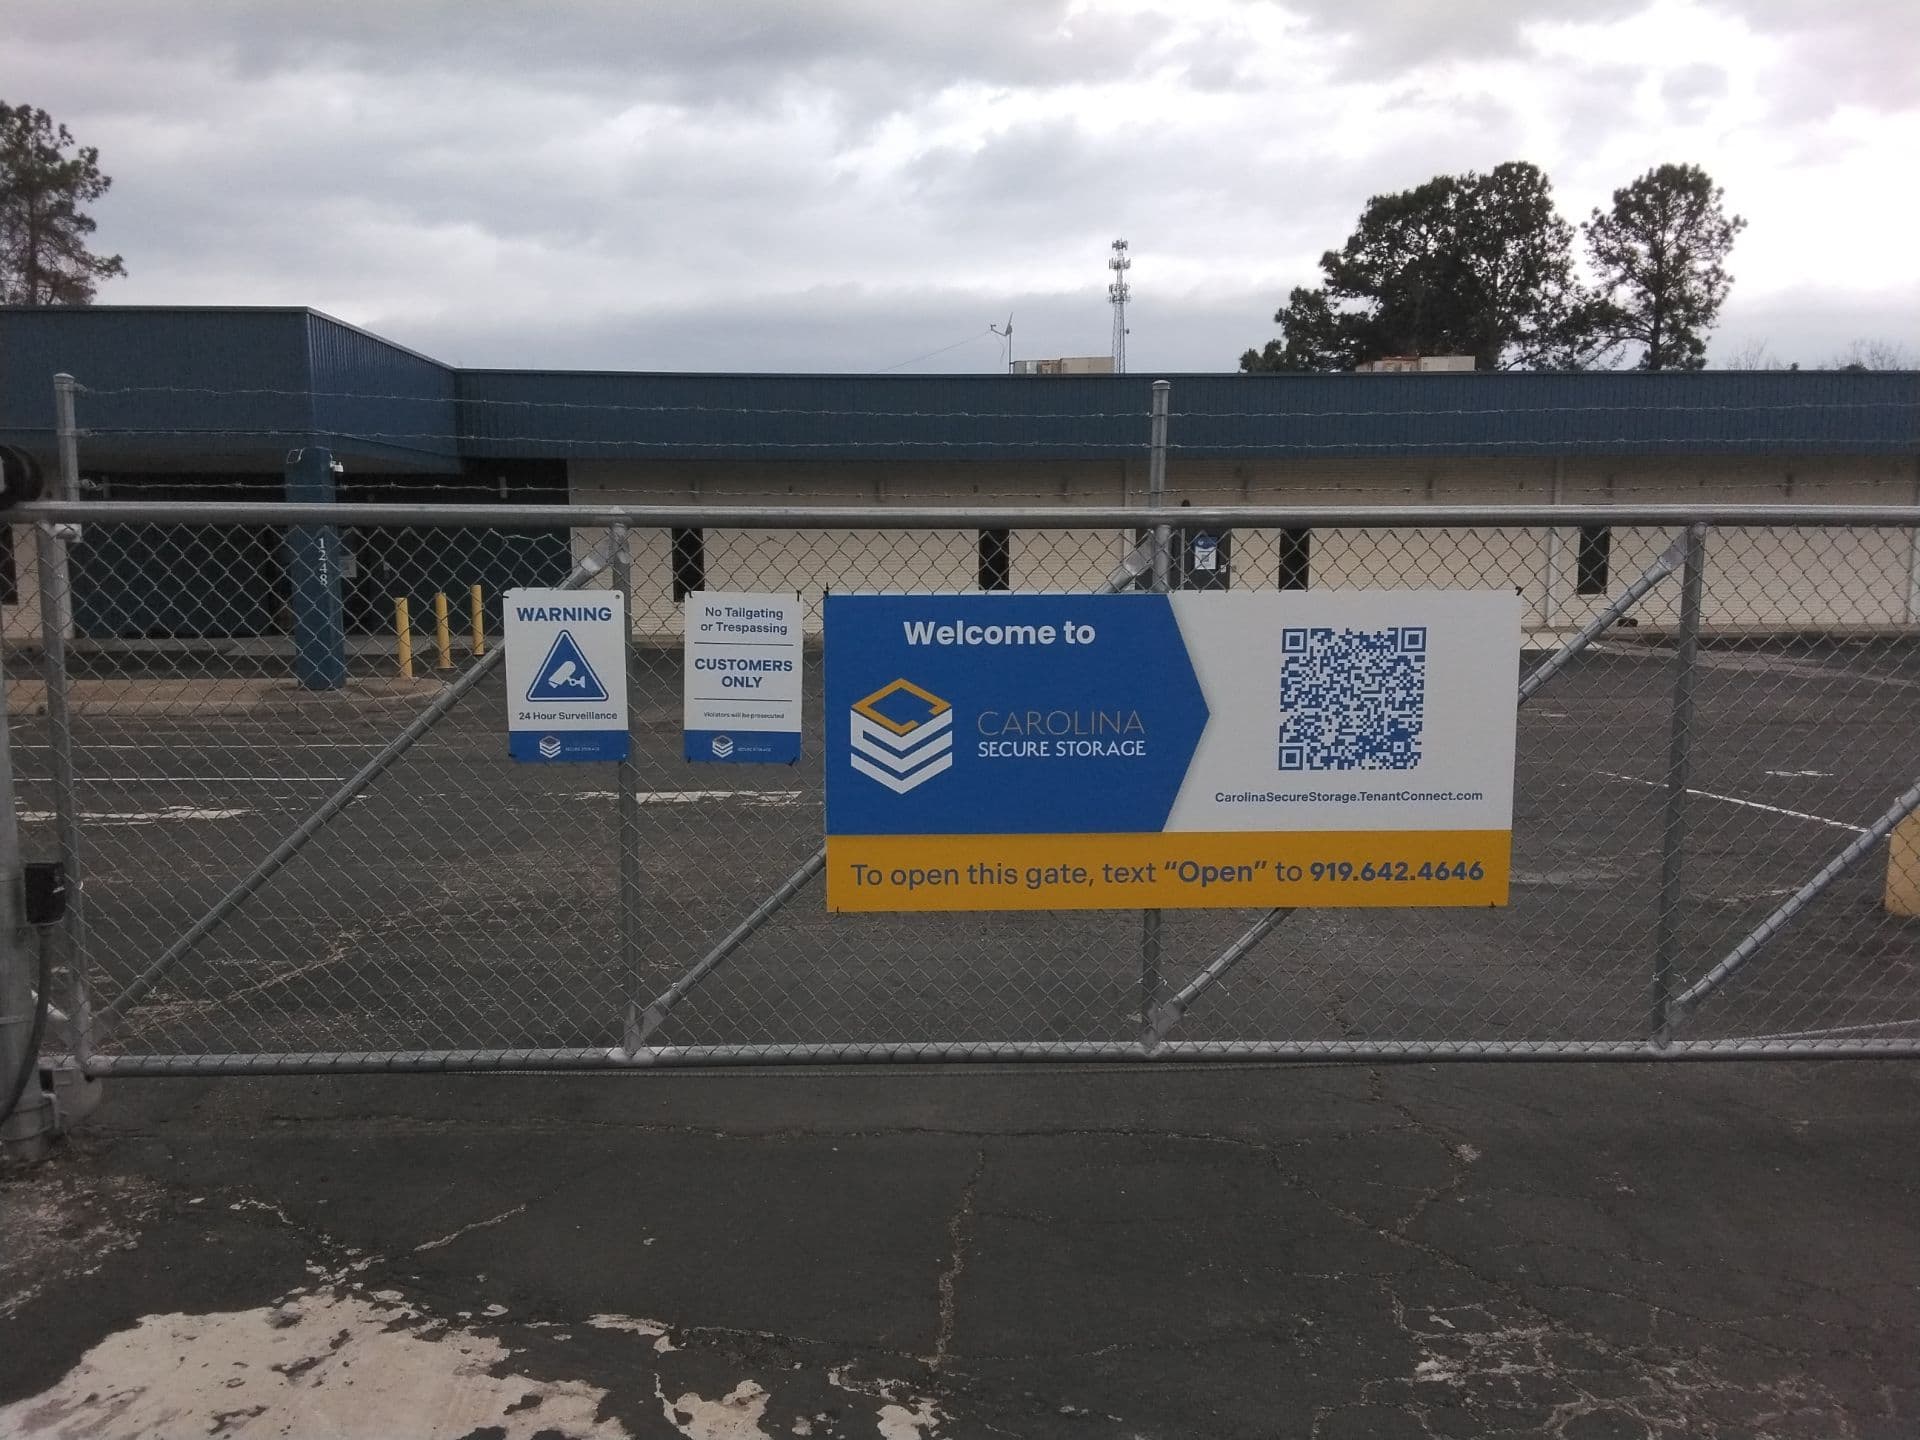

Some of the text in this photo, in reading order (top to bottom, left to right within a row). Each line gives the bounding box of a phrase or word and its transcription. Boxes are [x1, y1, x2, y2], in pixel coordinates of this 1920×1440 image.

[318, 537, 328, 585] 1248
[516, 606, 612, 622] WARNING
[705, 607, 784, 621] No Tailgating
[700, 622, 788, 635] or Trespassing
[903, 620, 1096, 646] Welcome to
[695, 658, 793, 672] CUSTOMERS
[721, 676, 763, 688] ONLY
[518, 711, 618, 721] 24 Hour Surveillance
[977, 710, 1146, 736] CAROLINA
[977, 740, 1147, 758] SECURE STORAGE
[1214, 790, 1483, 805] CarolinaSecureStorage.TenantConnect.com
[851, 863, 883, 886] To
[890, 866, 960, 890] open
[966, 862, 1018, 886] this
[1025, 864, 1095, 890] gate,
[1102, 862, 1157, 884] text
[1275, 861, 1303, 883] to
[1310, 860, 1485, 883] 919.642.4646
